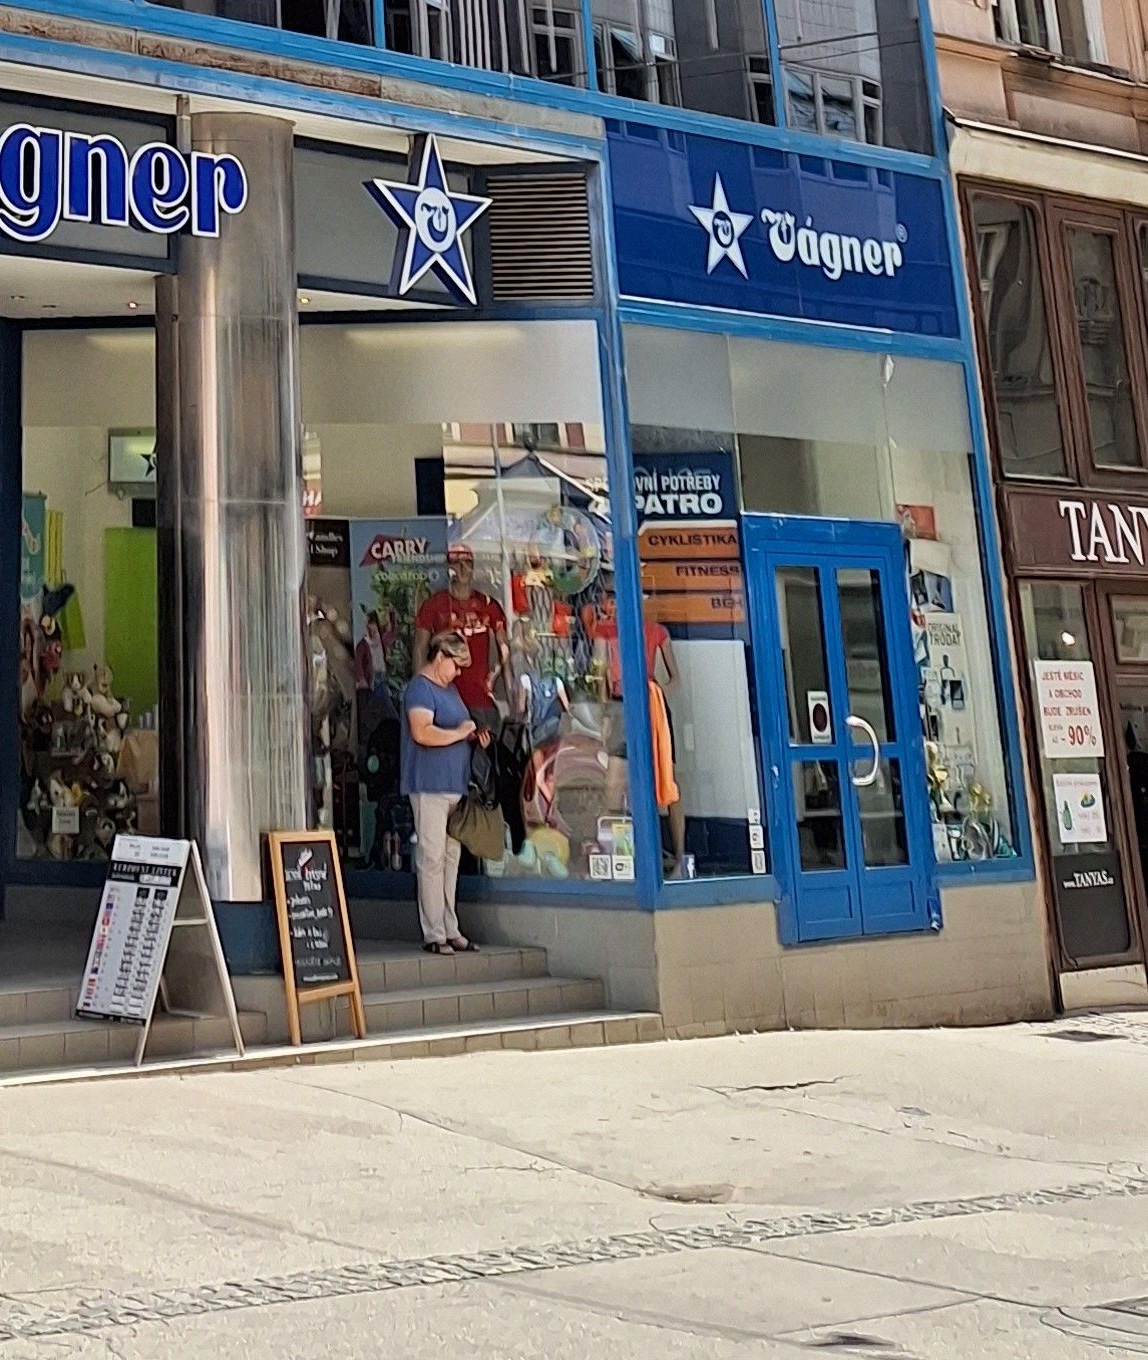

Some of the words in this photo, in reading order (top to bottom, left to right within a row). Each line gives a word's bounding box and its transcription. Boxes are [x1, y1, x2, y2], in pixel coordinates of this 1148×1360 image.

[760, 207, 903, 281] Vágner
[371, 537, 428, 559] CARRY
[648, 534, 737, 547] CYKLISTIKA
